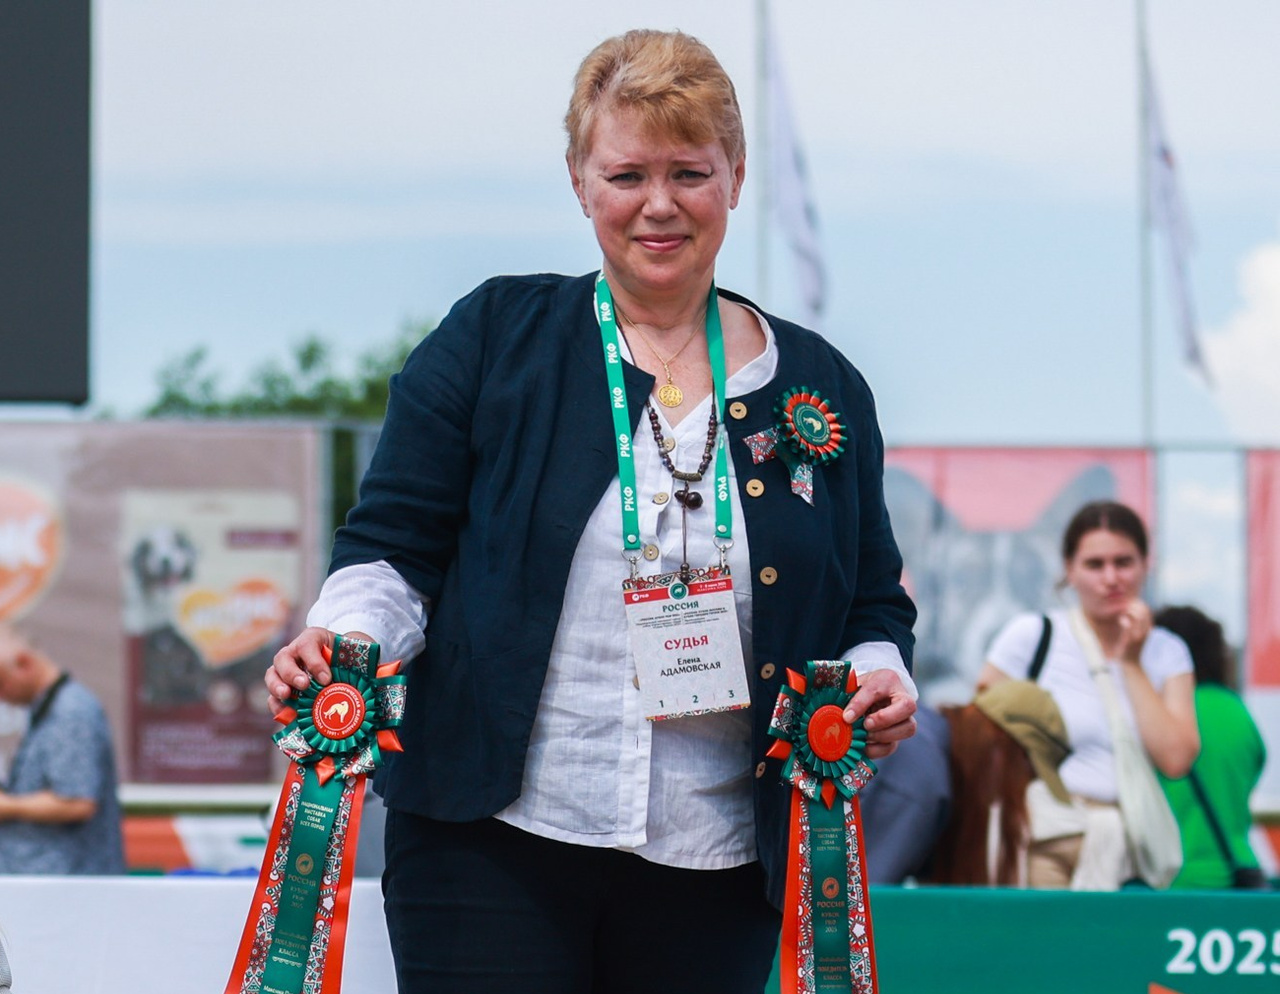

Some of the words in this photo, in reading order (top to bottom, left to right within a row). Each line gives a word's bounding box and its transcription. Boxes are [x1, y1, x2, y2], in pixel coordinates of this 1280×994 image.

[600, 302, 613, 321] РКФ
[606, 342, 618, 363] РКФ
[613, 387, 625, 408] РКФ
[619, 433, 631, 457] РКФ
[717, 476, 728, 501] РКФ
[623, 486, 635, 511] РКФ
[663, 601, 699, 612] РОССИЯ
[664, 635, 709, 650] СУДЬЯ
[660, 662, 721, 677] АДАМОВСКАЯ
[677, 657, 701, 665] Елена
[659, 700, 664, 708] 1
[692, 695, 699, 704] 2
[728, 689, 735, 698] 3
[288, 874, 316, 887] РОССИЯ
[279, 948, 299, 958] КЛАССА
